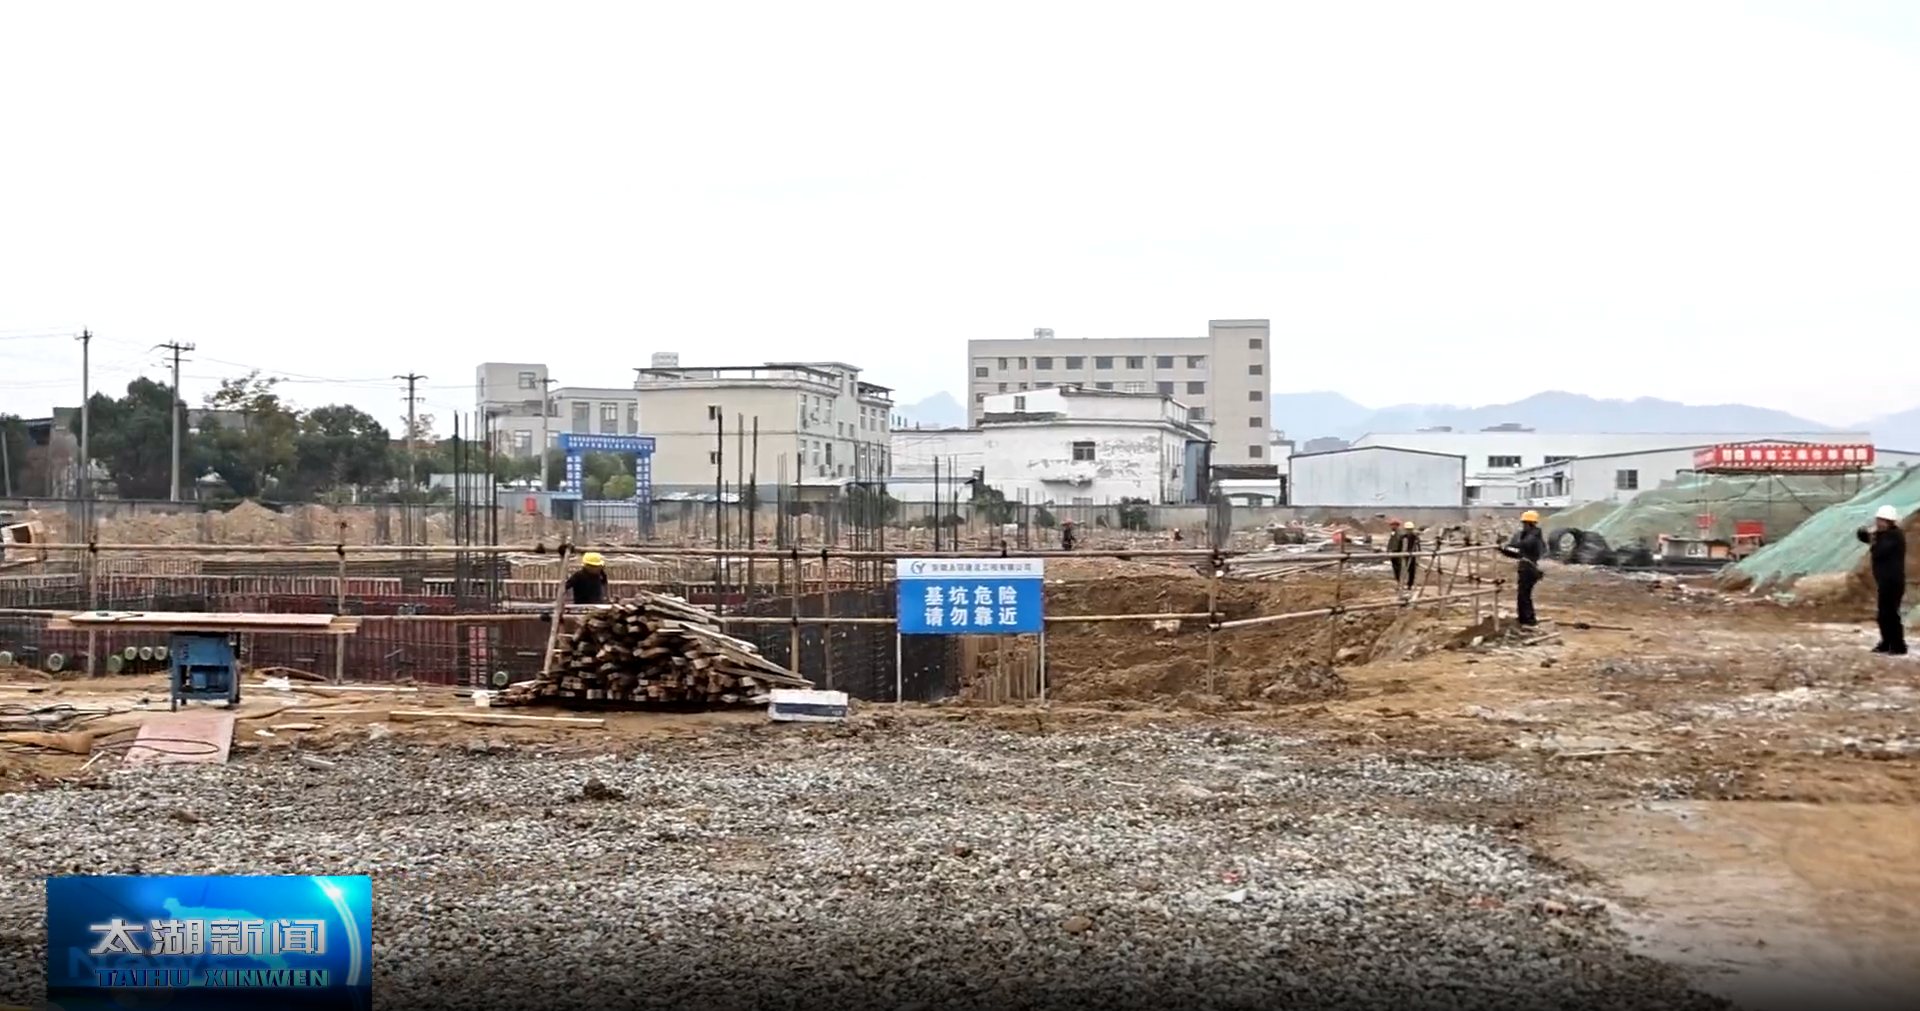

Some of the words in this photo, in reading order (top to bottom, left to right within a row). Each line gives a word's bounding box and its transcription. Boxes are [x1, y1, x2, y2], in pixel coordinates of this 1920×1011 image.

[924, 586, 1018, 605] 基坑危险
[924, 606, 1018, 626] 请勿靠近
